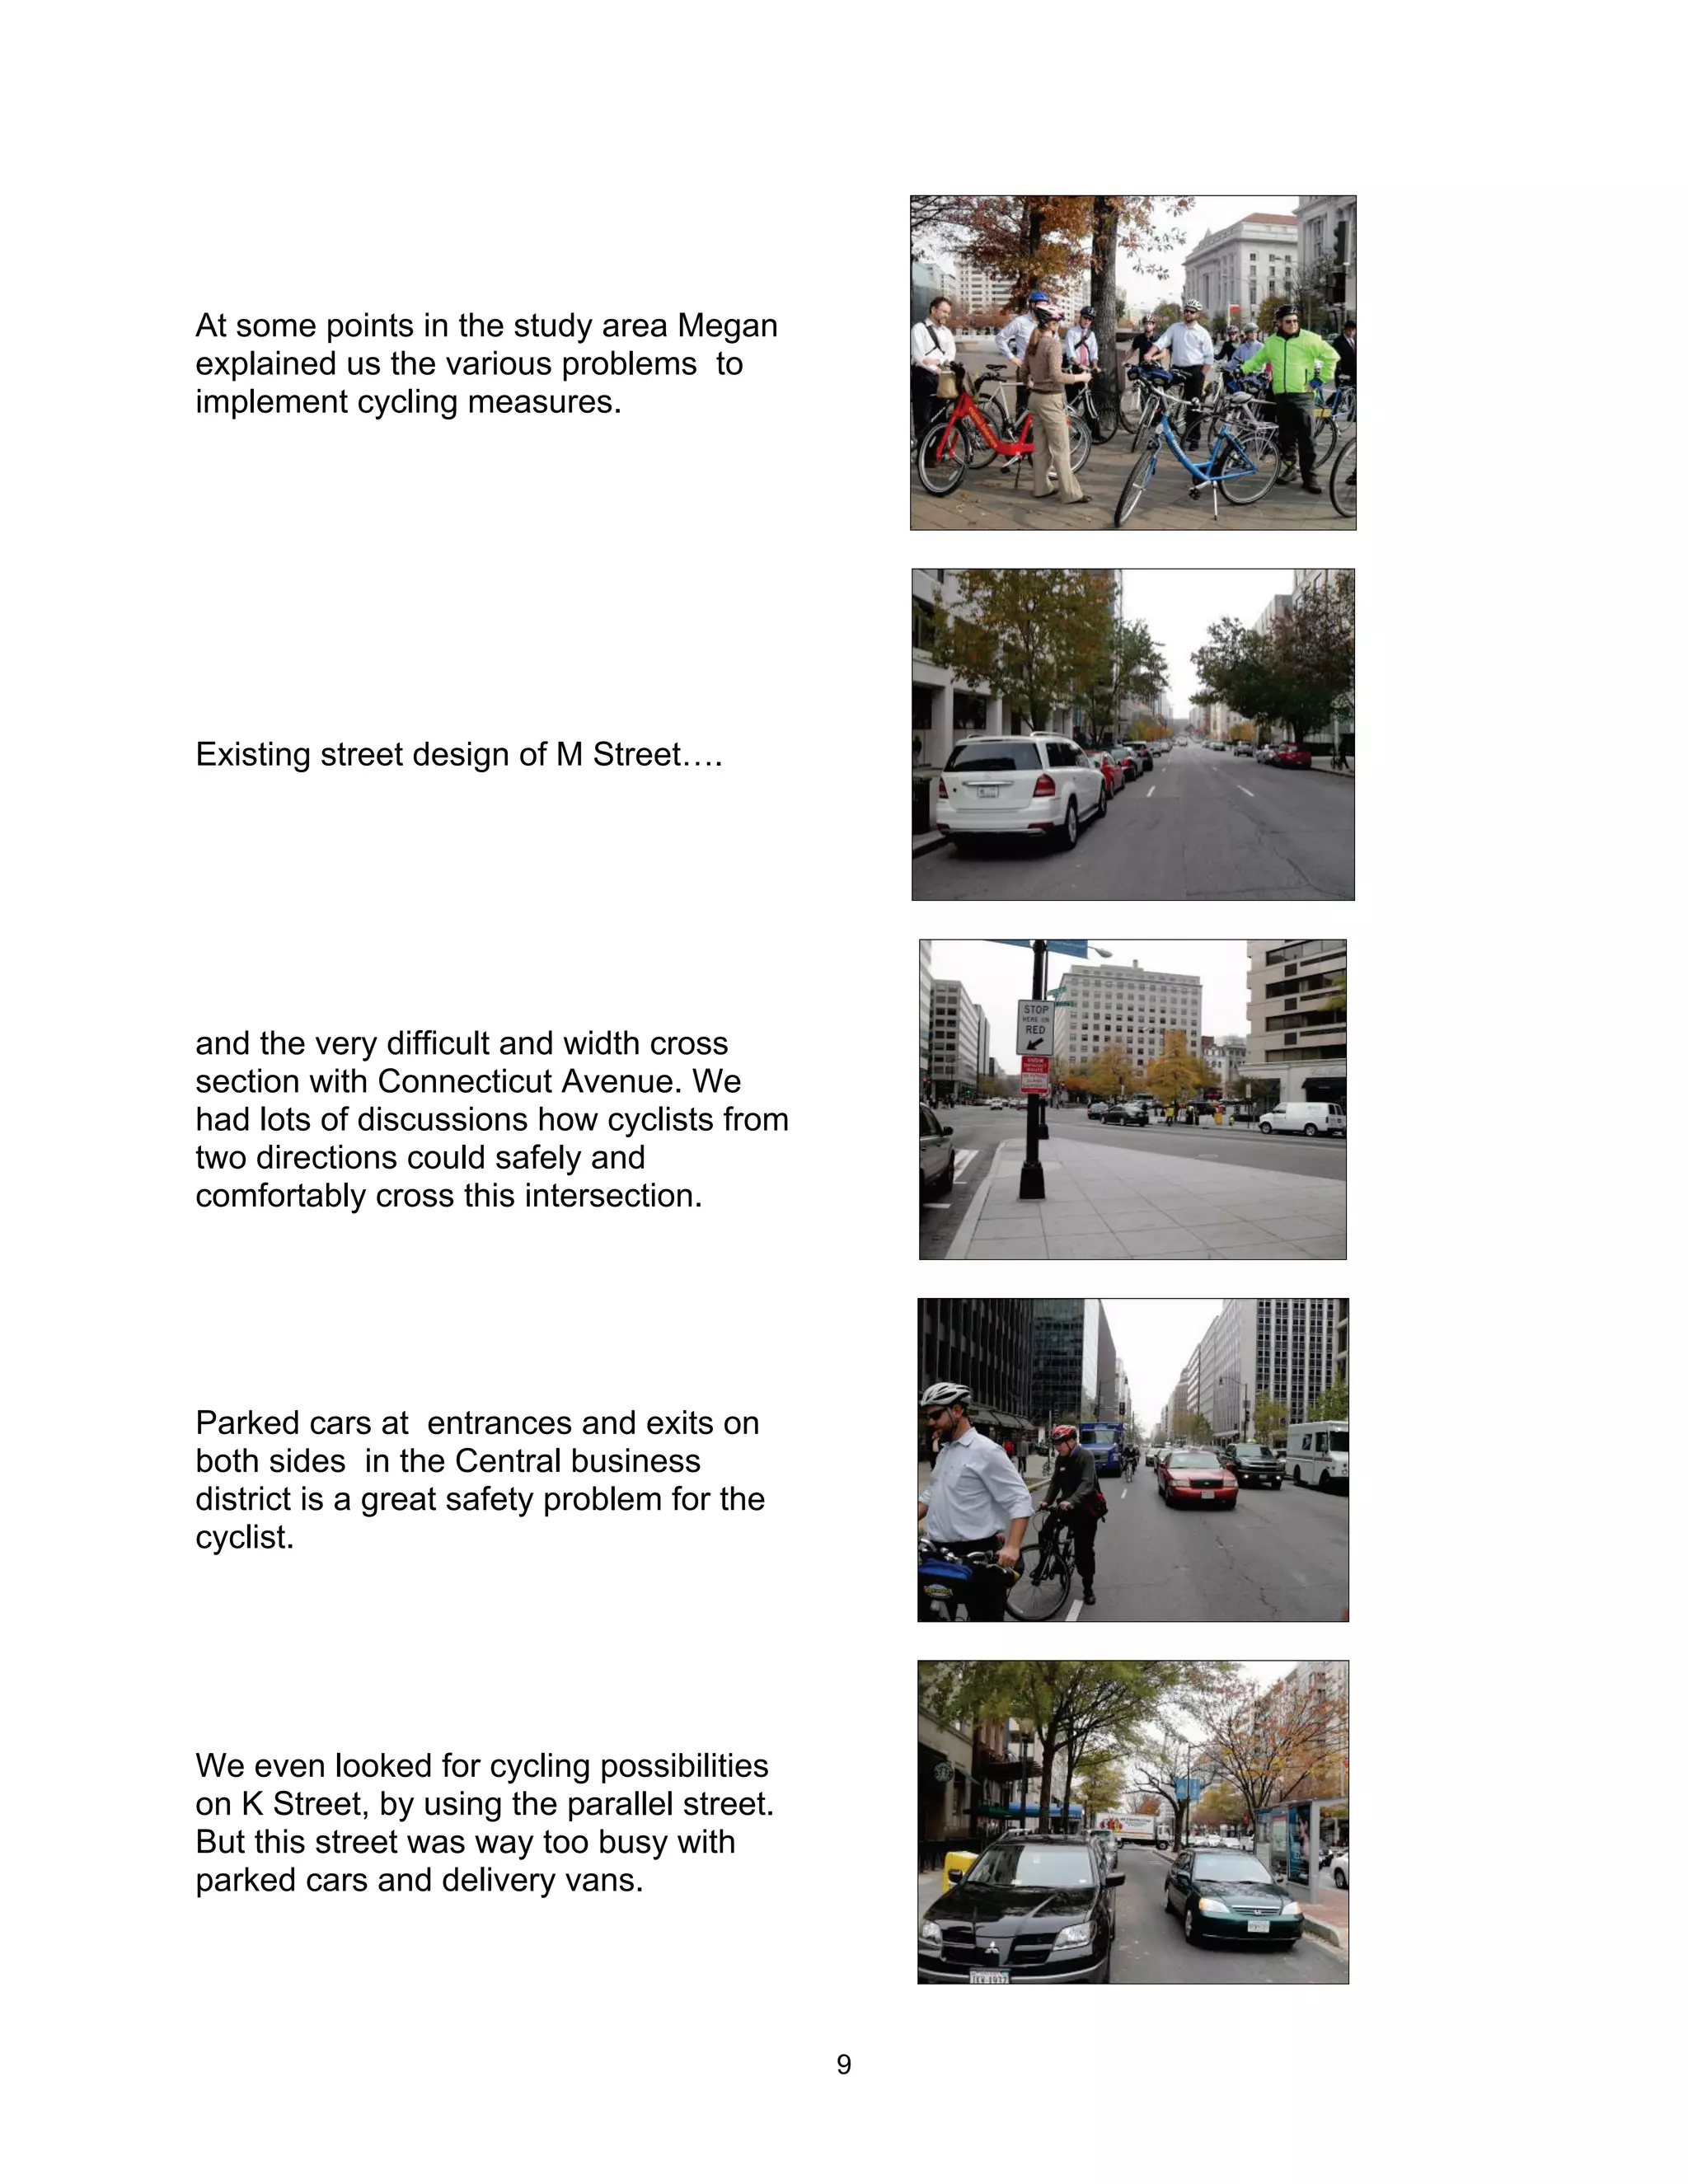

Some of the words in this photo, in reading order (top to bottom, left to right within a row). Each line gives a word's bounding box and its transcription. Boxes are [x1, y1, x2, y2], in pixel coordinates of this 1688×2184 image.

[195, 312, 227, 338] At
[237, 318, 316, 338] some
[327, 312, 414, 344] points
[424, 312, 448, 337] in
[458, 312, 504, 338] the
[514, 312, 593, 344] study
[603, 318, 668, 338] area
[679, 312, 777, 344] Megan
[196, 350, 335, 382] explained
[348, 356, 381, 376] us
[390, 350, 436, 376] the
[446, 350, 552, 376] various
[563, 350, 697, 382] problems
[715, 351, 743, 376] to
[197, 388, 349, 420] implement
[358, 388, 457, 420] cycling
[469, 394, 621, 414] measures.
[197, 741, 310, 773] Existing
[321, 742, 404, 766] street
[413, 741, 509, 773] design
[519, 740, 549, 766] of
[558, 741, 582, 766] M
[1024, 1004, 1049, 1015] STOP
[1025, 1024, 1046, 1034] RED
[196, 1029, 249, 1056] and
[260, 1029, 305, 1056] the
[315, 1036, 377, 1062] very
[387, 1029, 490, 1056] difficult
[499, 1029, 553, 1056] and
[563, 1029, 640, 1056] width
[650, 1036, 729, 1056] cross
[196, 1068, 299, 1094] section
[309, 1068, 367, 1094] with
[378, 1067, 553, 1094] Connecticut
[560, 1068, 681, 1094] Avenue.
[692, 1068, 741, 1094] We
[197, 1106, 249, 1132] had
[260, 1105, 311, 1132] lots
[321, 1105, 350, 1132] of
[358, 1106, 528, 1132] discussions
[539, 1106, 598, 1132] how
[608, 1105, 714, 1138] cyclists
[723, 1105, 788, 1132] from
[195, 1145, 246, 1169] two
[256, 1144, 397, 1169] directions
[407, 1144, 485, 1169] could
[495, 1143, 582, 1176] safely
[591, 1144, 645, 1169] and
[196, 1182, 367, 1214] comfortably
[376, 1188, 454, 1207] cross
[464, 1182, 515, 1207] this
[526, 1182, 701, 1207] intersection.
[197, 1409, 298, 1435] Parked
[310, 1415, 372, 1435] cars
[382, 1410, 410, 1435] at
[428, 1410, 572, 1435] entrances
[582, 1409, 635, 1435] and
[646, 1409, 714, 1435] exits
[724, 1415, 759, 1435] on
[197, 1447, 259, 1474] both
[270, 1447, 346, 1474] sides
[366, 1447, 389, 1473] in
[400, 1447, 445, 1473] the
[456, 1447, 560, 1474] Central
[572, 1447, 701, 1474] business
[195, 1485, 292, 1511] district
[302, 1485, 324, 1511] is
[334, 1492, 351, 1511] a
[361, 1486, 437, 1518] great
[446, 1485, 534, 1518] safety
[544, 1485, 661, 1517] problem
[671, 1485, 711, 1511] for
[720, 1485, 765, 1511] the
[196, 1523, 293, 1556] cyclist.
[195, 1752, 245, 1778] We
[255, 1758, 325, 1778] even
[336, 1752, 431, 1778] looked
[441, 1752, 481, 1778] for
[490, 1752, 589, 1784] cycling
[602, 1752, 769, 1784] possibilities
[195, 1797, 231, 1816] on
[243, 1790, 264, 1816] K
[274, 1790, 368, 1821] Street,
[381, 1790, 415, 1823] by
[424, 1790, 501, 1822] using
[512, 1790, 557, 1816] the
[569, 1790, 673, 1822] parallel
[683, 1791, 773, 1816] street.
[197, 1828, 246, 1854] But
[254, 1828, 305, 1854] this
[316, 1829, 398, 1854] street
[406, 1835, 466, 1854] was
[475, 1835, 534, 1861] way
[543, 1829, 588, 1854] too
[599, 1828, 668, 1861] busy
[677, 1828, 735, 1854] with
[197, 1867, 295, 1898] parked
[307, 1872, 368, 1892] cars
[377, 1867, 431, 1892] and
[443, 1866, 556, 1899] delivery
[565, 1872, 642, 1892] vans.
[837, 2053, 851, 2075] 9
